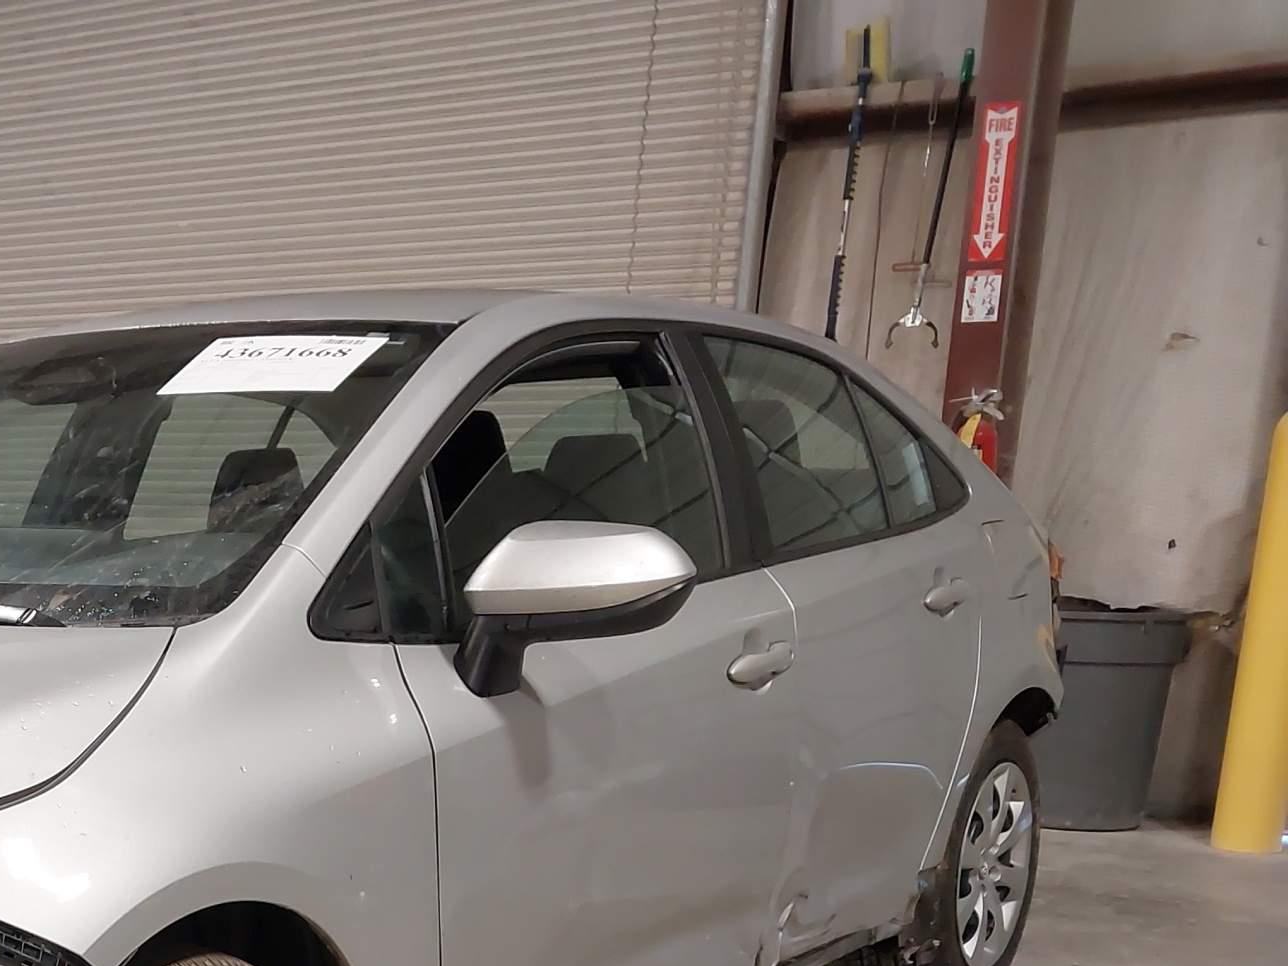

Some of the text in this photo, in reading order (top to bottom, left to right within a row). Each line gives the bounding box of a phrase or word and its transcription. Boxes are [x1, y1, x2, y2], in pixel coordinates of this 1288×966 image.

[988, 117, 1015, 133] FIRE
[982, 138, 1004, 249] EXTINGUISHER
[215, 347, 353, 359] 43671668
